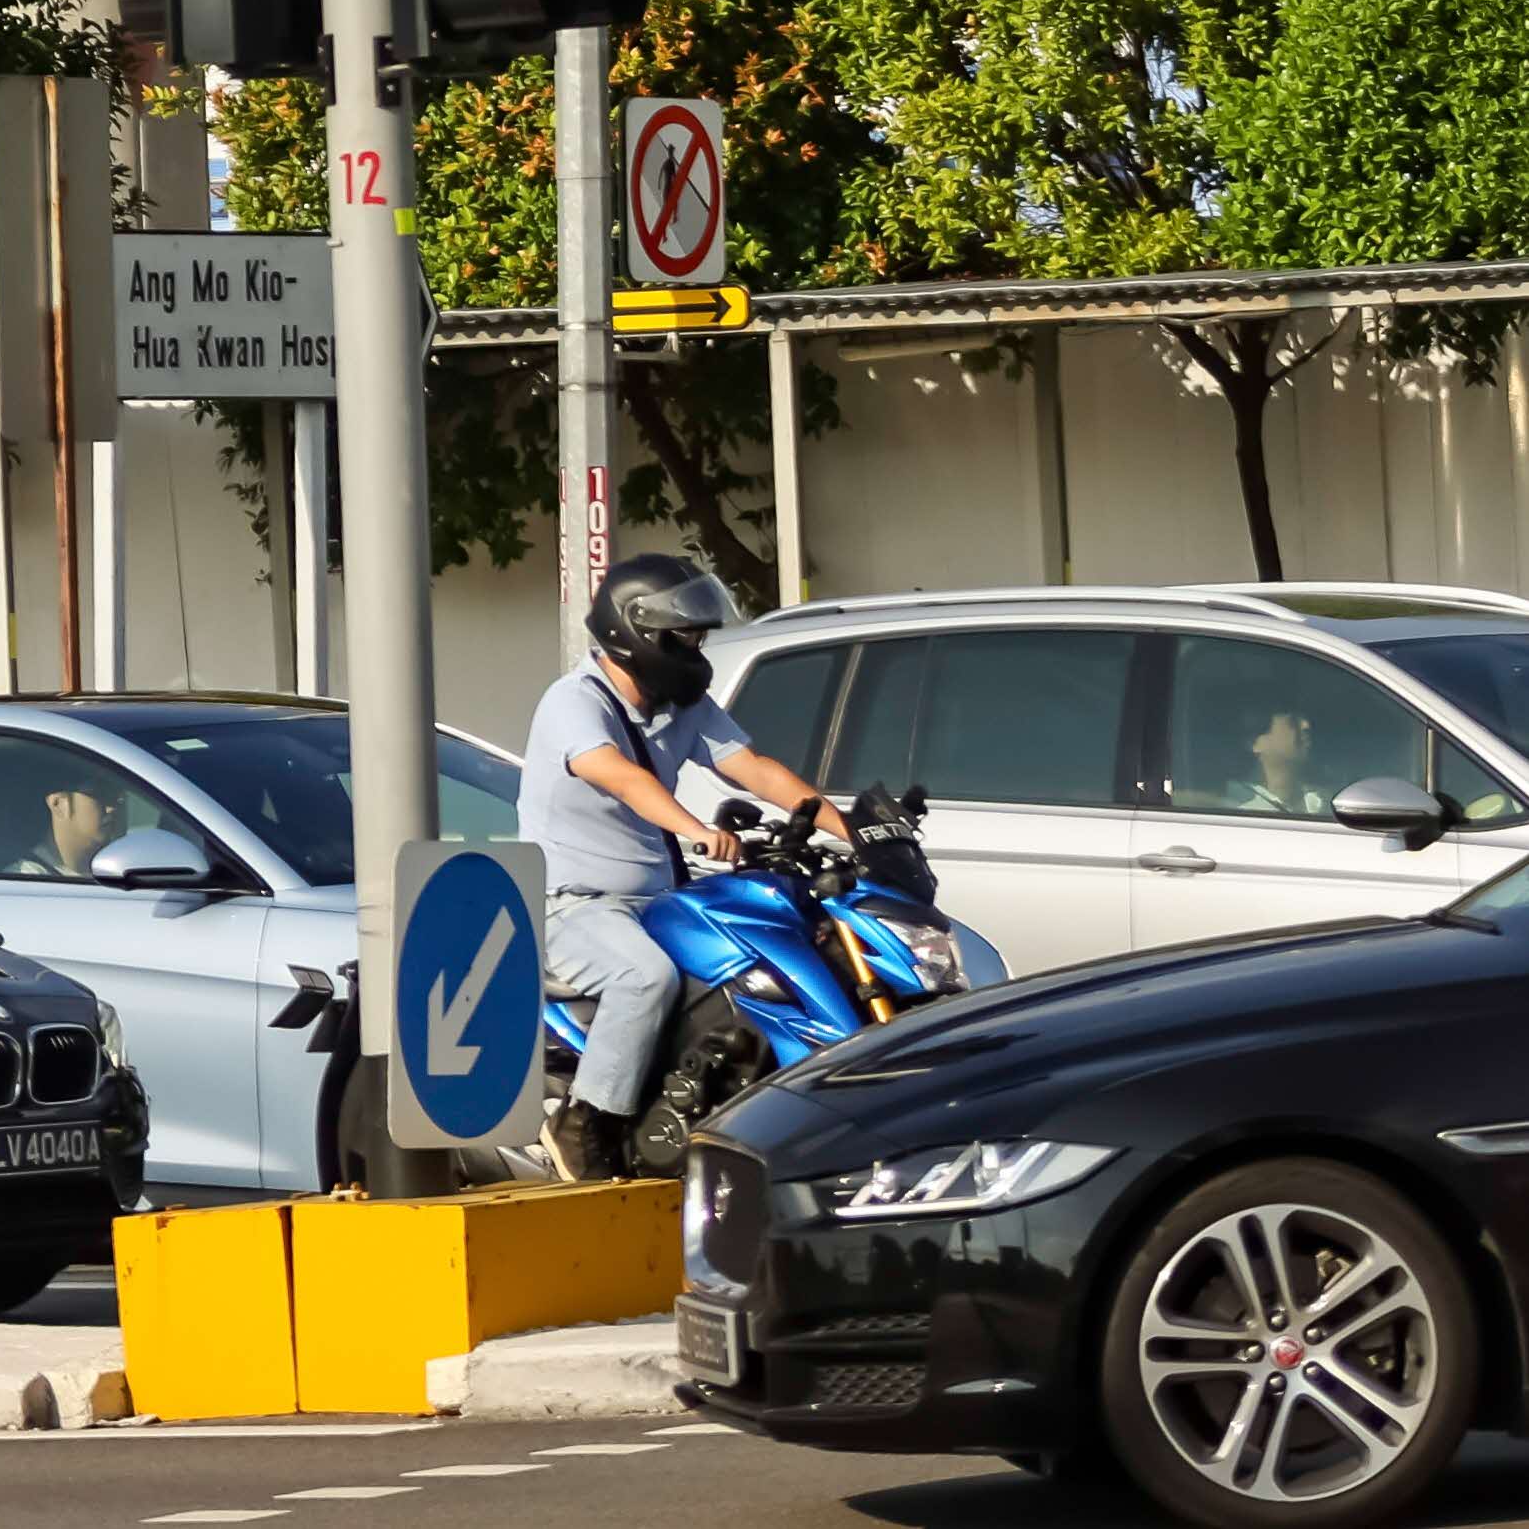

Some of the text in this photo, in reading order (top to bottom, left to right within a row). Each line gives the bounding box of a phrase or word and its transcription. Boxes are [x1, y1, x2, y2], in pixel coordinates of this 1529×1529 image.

[340, 150, 387, 206] 12
[130, 259, 298, 313] Ang Mo Kio-
[133, 325, 179, 368] Hua
[197, 325, 264, 368] Kwan
